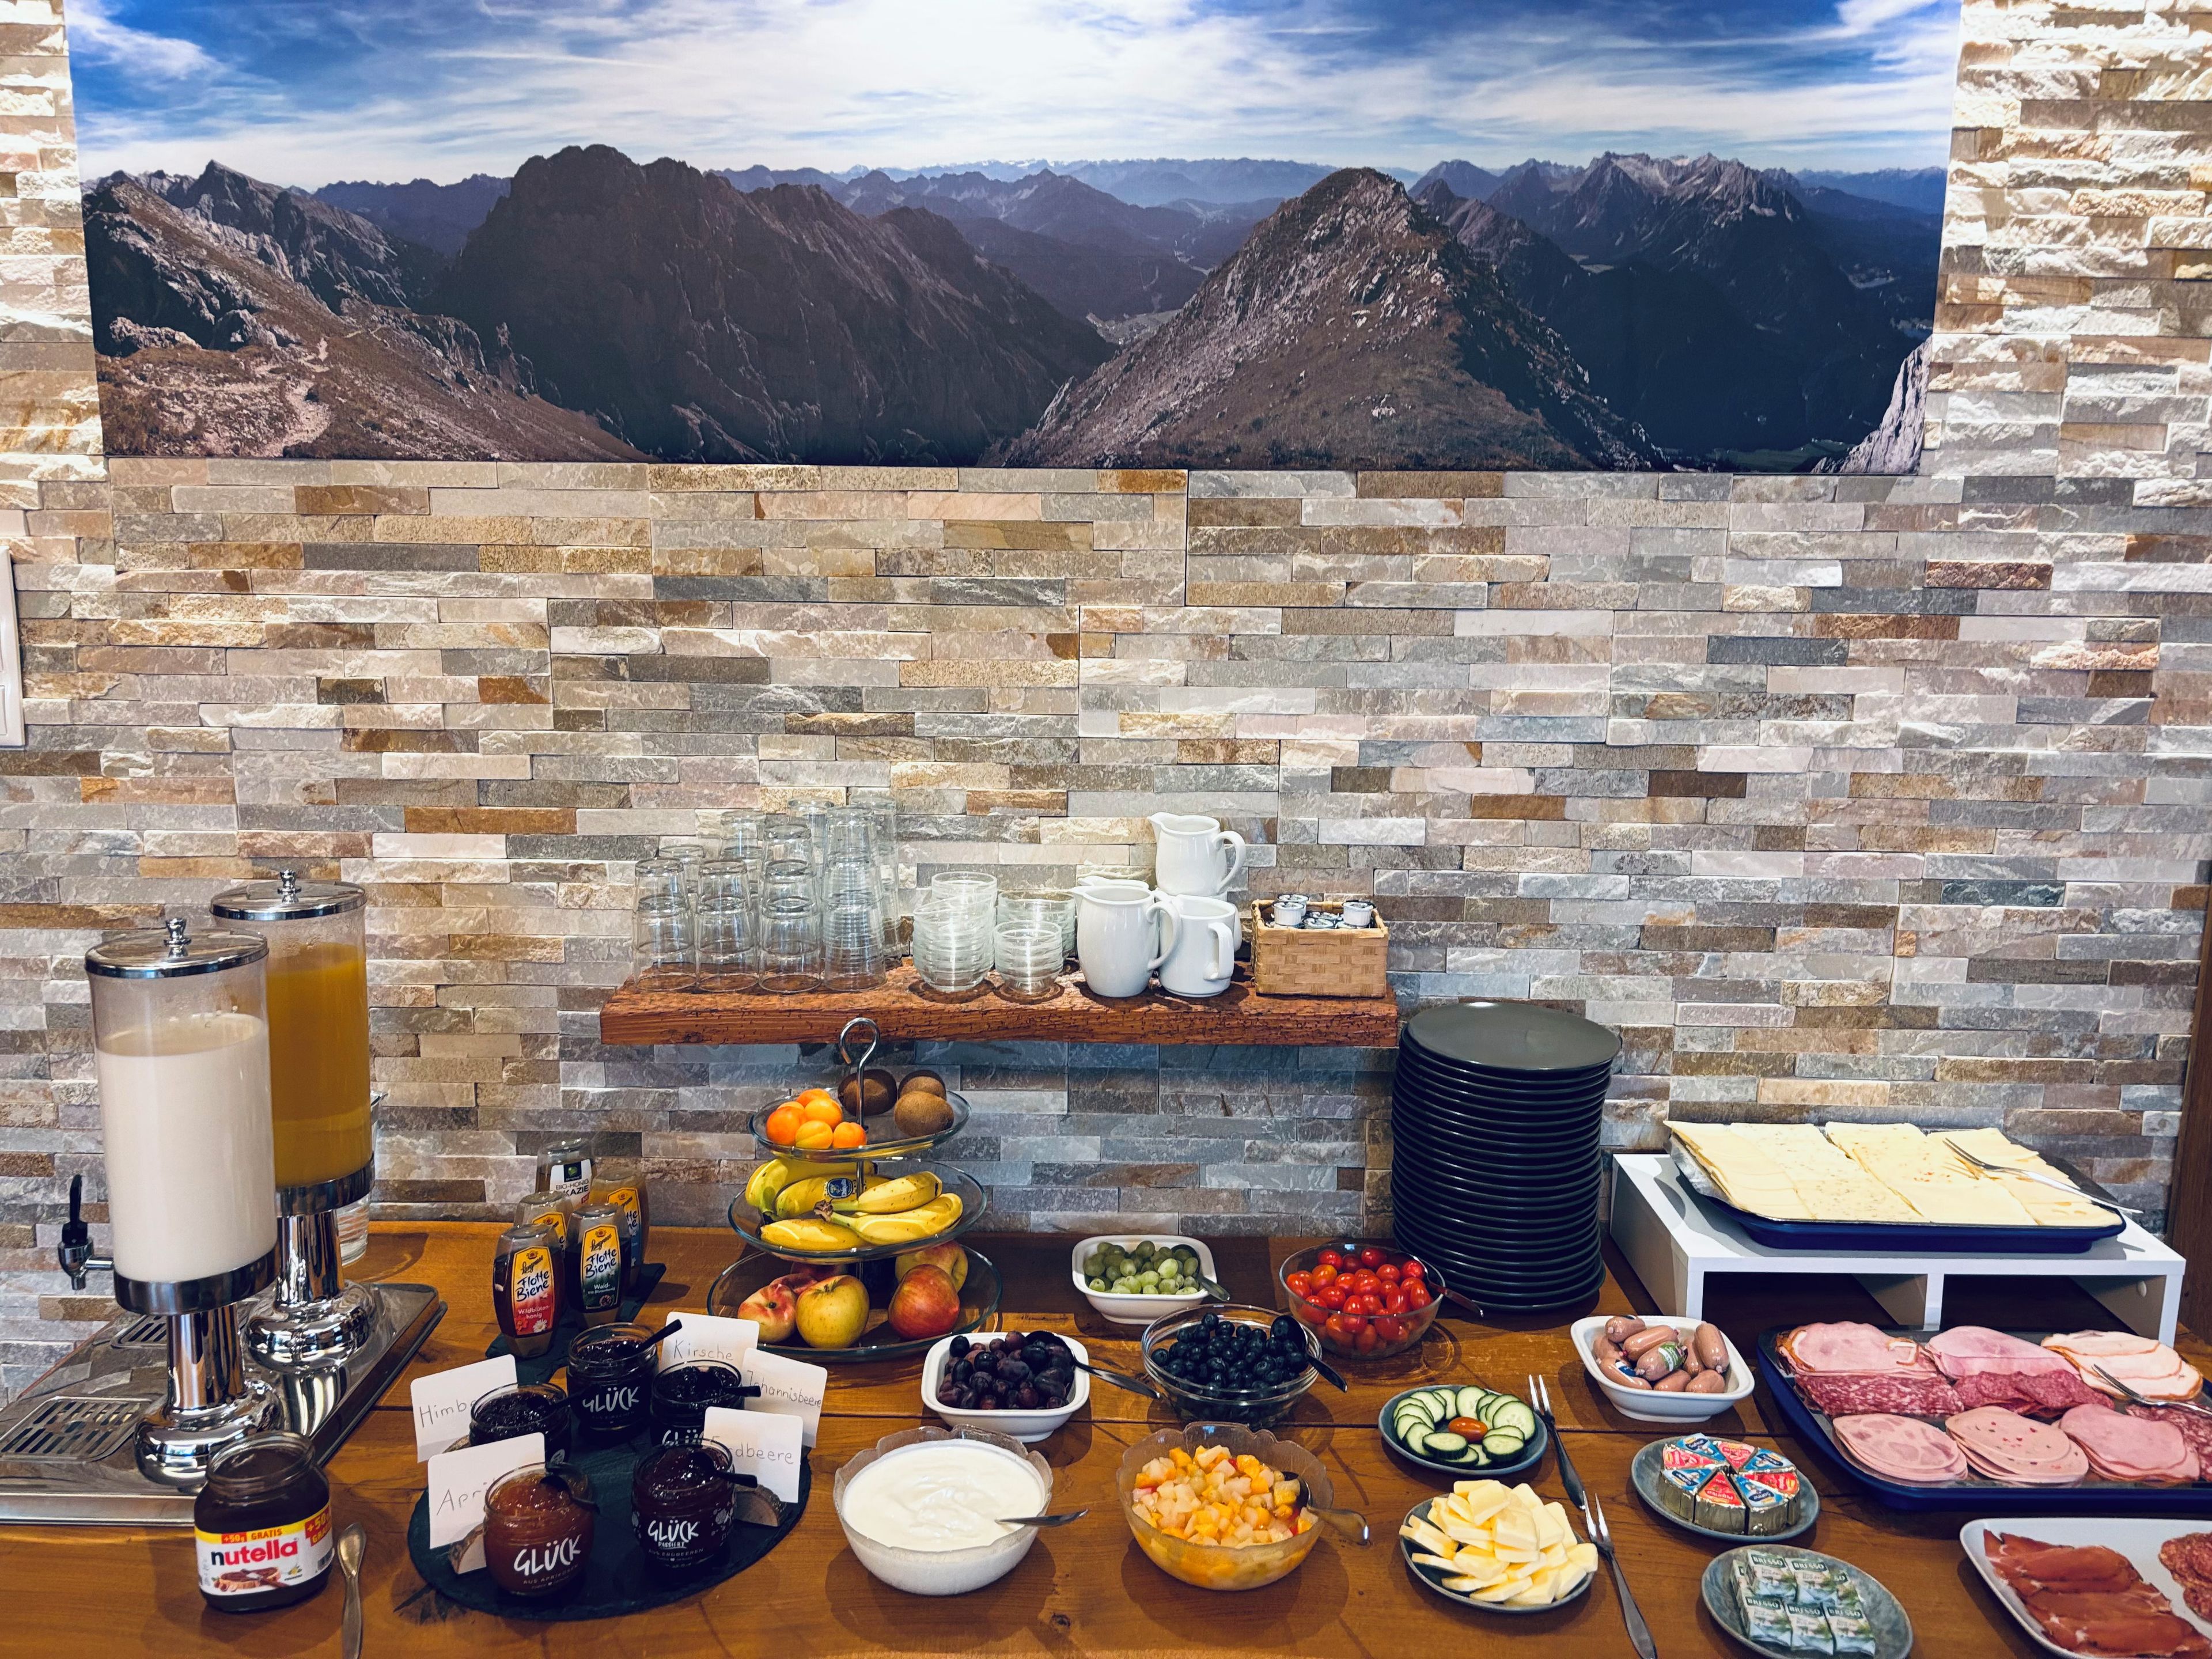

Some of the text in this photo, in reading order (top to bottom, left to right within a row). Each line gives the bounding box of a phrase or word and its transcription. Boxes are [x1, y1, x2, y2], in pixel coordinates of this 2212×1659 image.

[563, 1185, 589, 1196] KAZIE
[586, 1249, 618, 1265] Flotte
[585, 1258, 616, 1278] Biene
[517, 1270, 550, 1289] Flotte
[515, 1279, 550, 1302] Biene
[518, 1305, 551, 1315] Wildblüten-
[674, 1339, 733, 1361] Kirsche
[224, 1528, 283, 1543] +50g GRATIS
[647, 1519, 699, 1543] GLÜCK
[211, 1539, 298, 1566] nutella
[514, 1534, 582, 1576] GLÜCK
[1752, 1556, 1783, 1567] BRESSO
[1794, 1561, 1825, 1570] BRESSO
[1747, 1597, 1779, 1610] BRESSO
[1789, 1605, 1821, 1616] BRESSO
